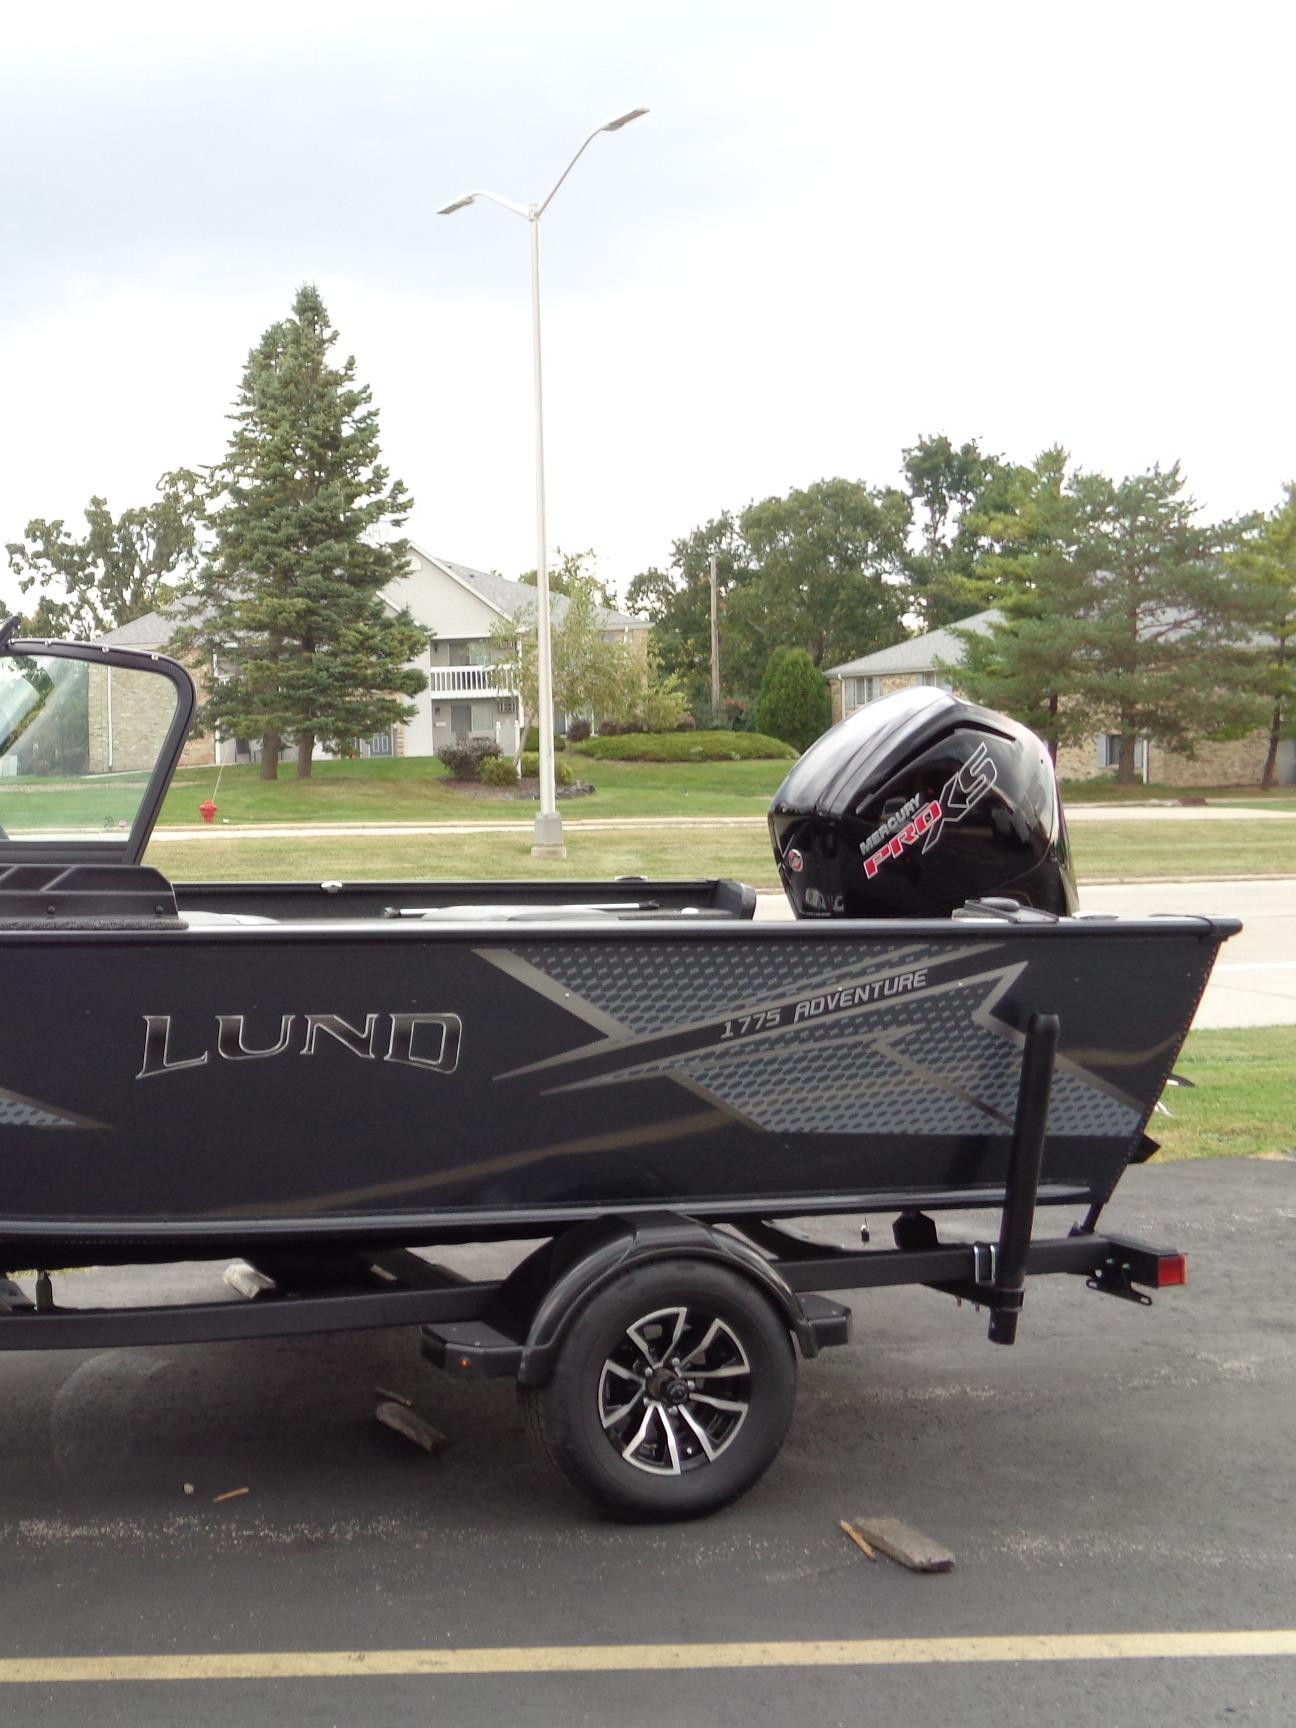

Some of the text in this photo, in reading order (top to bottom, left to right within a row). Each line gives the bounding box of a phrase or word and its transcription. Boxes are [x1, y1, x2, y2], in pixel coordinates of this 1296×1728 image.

[859, 792, 921, 856] MERCURY
[863, 741, 998, 880] PRO XS
[720, 969, 928, 1039] 1775 ADVENTURE
[135, 1013, 463, 1080] LUND
